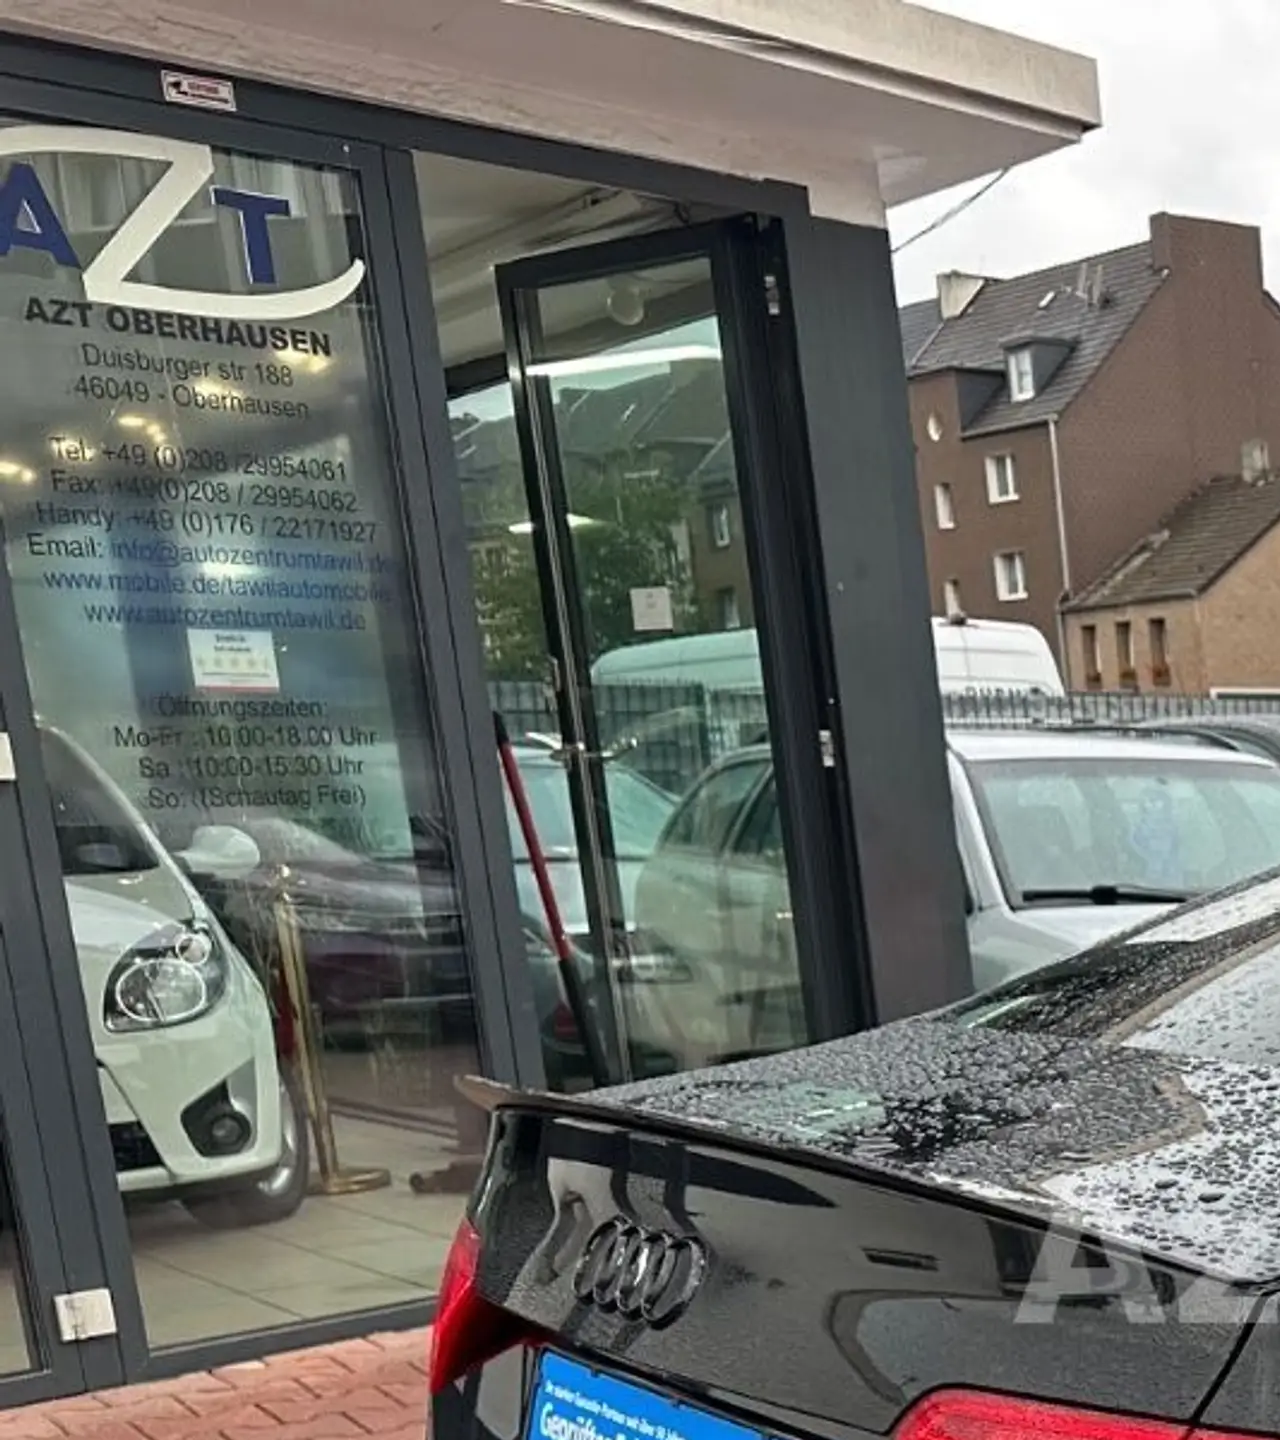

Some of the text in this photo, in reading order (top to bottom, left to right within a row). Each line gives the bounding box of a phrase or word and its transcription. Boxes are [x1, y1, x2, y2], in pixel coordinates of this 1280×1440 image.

[25, 297, 332, 357] AZT OBERHAUSEN
[81, 342, 293, 388] Duisburger str 188
[73, 374, 151, 403] 46049
[172, 384, 311, 420] Oberhausen
[102, 443, 147, 466] +49
[252, 485, 359, 513] 29954062
[181, 509, 254, 538] (0)176
[275, 515, 376, 544] 22171927
[28, 534, 103, 560] Email:
[338, 726, 378, 747] Uhr
[327, 755, 366, 776] Uhr
